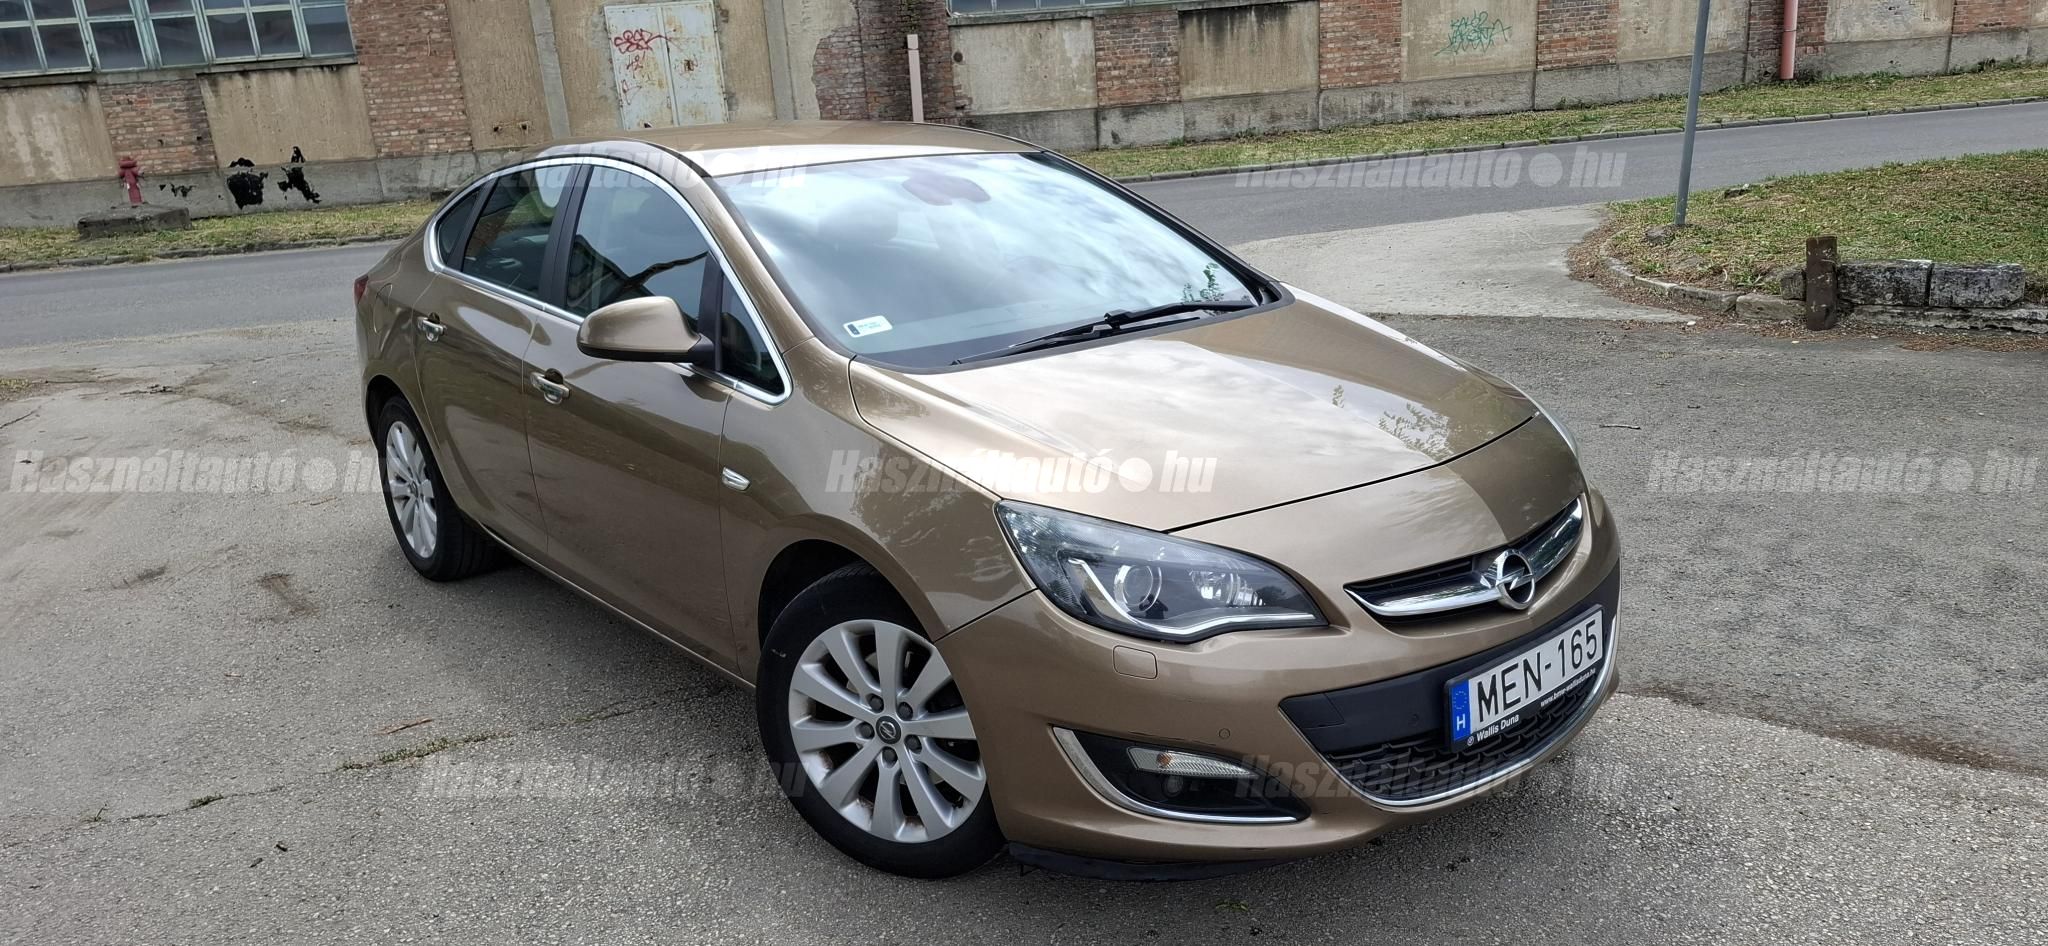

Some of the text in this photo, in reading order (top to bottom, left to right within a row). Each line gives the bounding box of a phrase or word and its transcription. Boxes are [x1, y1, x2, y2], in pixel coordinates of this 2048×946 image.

[1477, 619, 1597, 722] MEN-165
[1456, 713, 1466, 731] H
[1477, 714, 1519, 742] Wallis Duna
